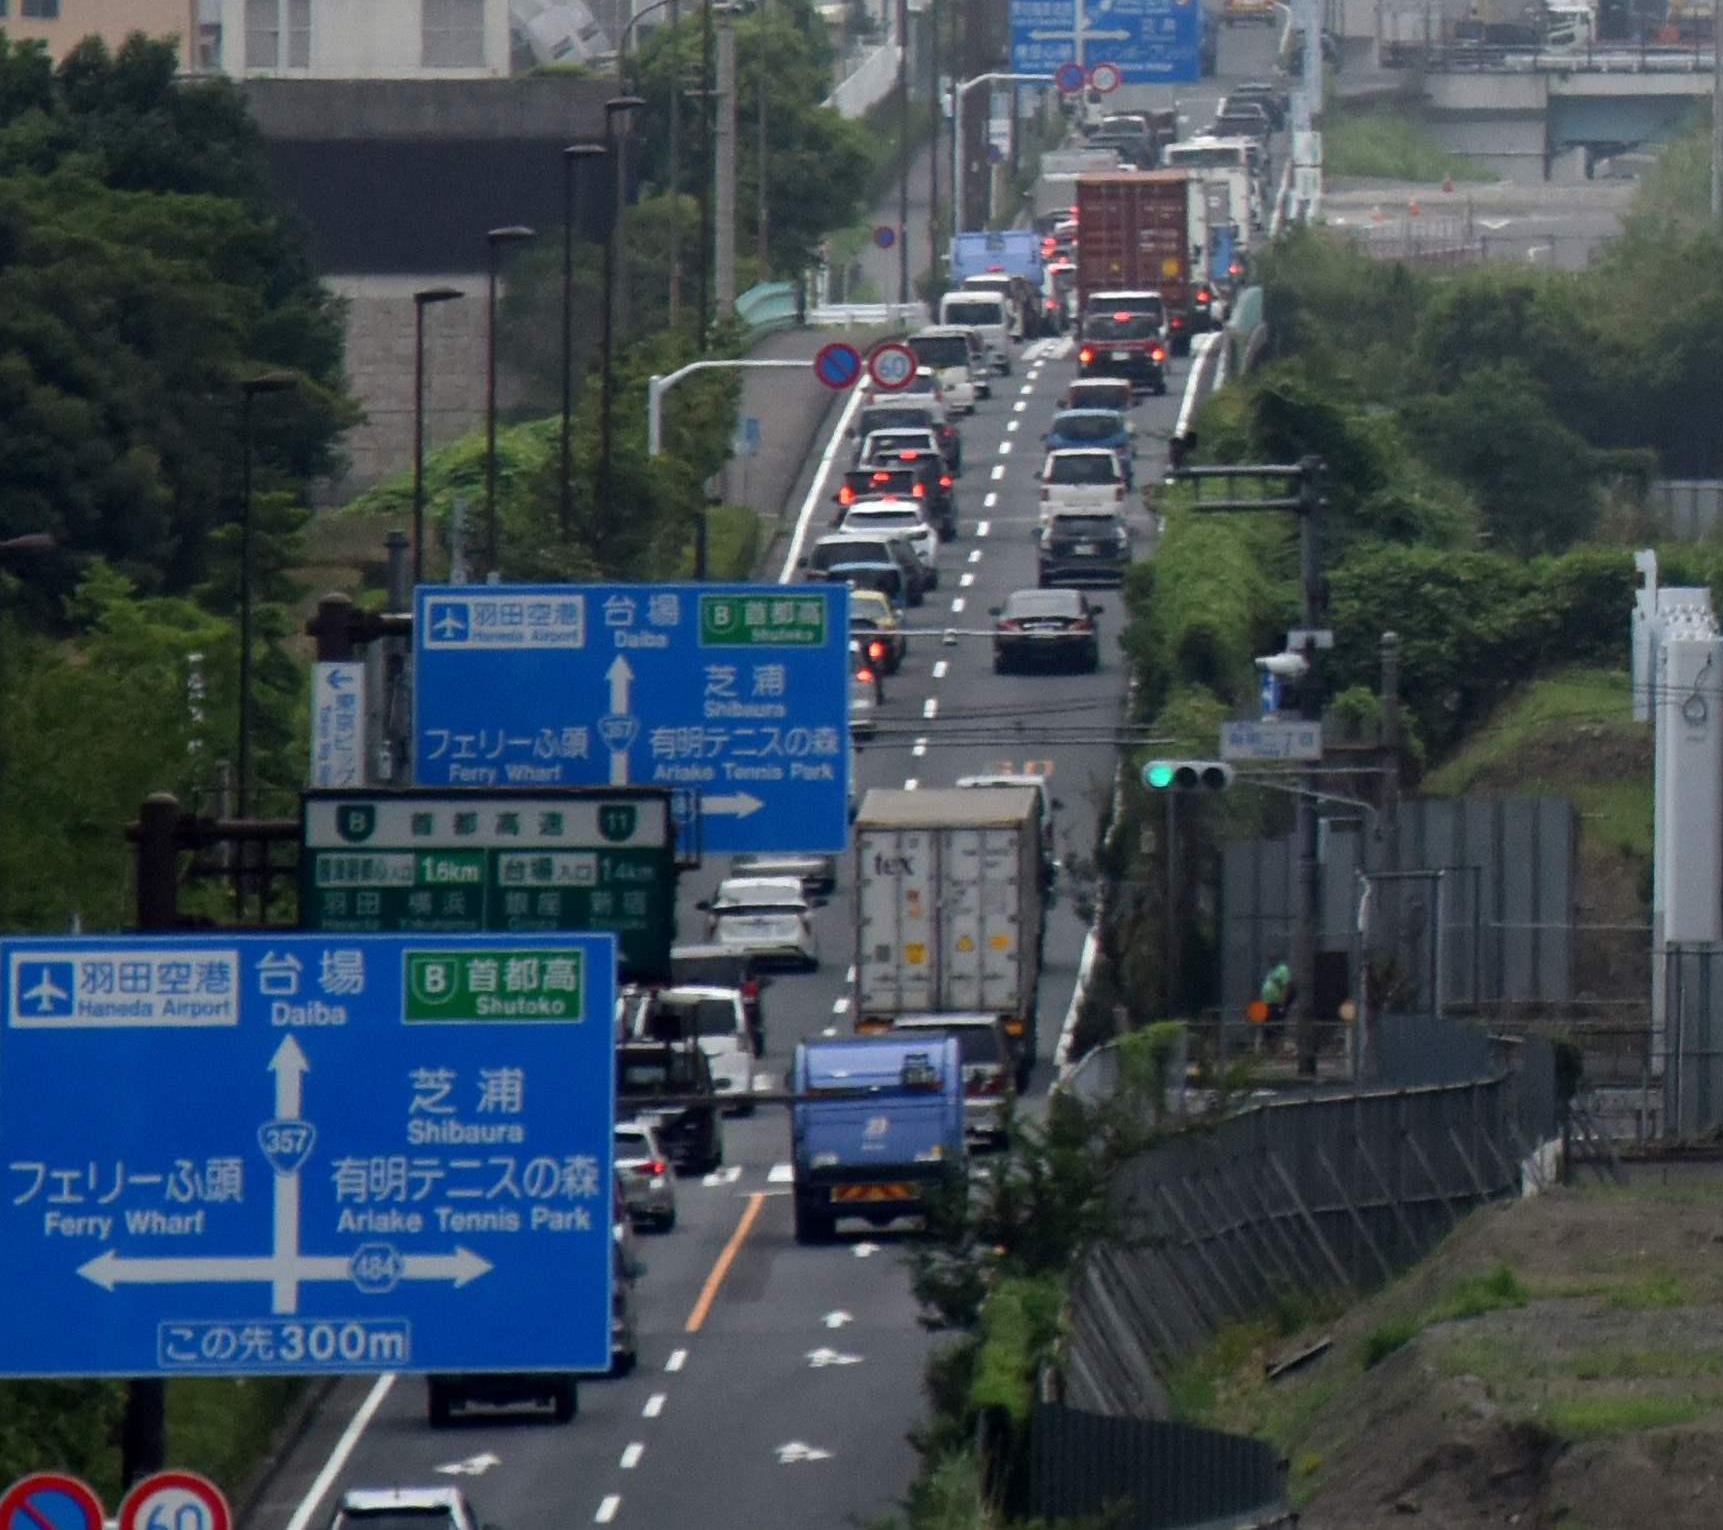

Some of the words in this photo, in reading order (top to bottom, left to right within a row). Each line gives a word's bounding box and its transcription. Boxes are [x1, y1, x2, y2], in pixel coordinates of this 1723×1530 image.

[474, 603, 577, 627] 羽田空港
[602, 594, 680, 627] 台場
[714, 605, 729, 625] B
[613, 631, 668, 648] Daiba
[704, 664, 785, 697] 芝浦
[704, 700, 786, 718] Shibaura
[424, 726, 588, 760] フェリーふ頭
[650, 726, 838, 760] 有明テニスの森
[449, 764, 496, 785] Ferry
[505, 764, 562, 782] Wharf
[653, 763, 715, 781] Ariake
[721, 763, 784, 781] Tennis
[790, 763, 834, 780] Park
[349, 814, 367, 832] B
[411, 811, 564, 836] 首都高速
[607, 814, 628, 832] 11
[80, 960, 232, 995] 羽田空港
[255, 949, 365, 995] 台場
[424, 965, 446, 993] B
[466, 958, 577, 993] 首都高
[78, 999, 152, 1018] Haneda
[162, 999, 230, 1019] Airport
[271, 1002, 347, 1026] Daiba
[475, 996, 566, 1015] Shutoko
[408, 1067, 525, 1114] 芝浦
[265, 1129, 307, 1155] 357
[407, 1119, 525, 1145] Shibaura
[10, 1157, 243, 1206] フェリーふ頭
[331, 1155, 599, 1204] 有明テニスの森
[44, 1210, 113, 1240] Ferry
[125, 1210, 205, 1235] Wharf
[337, 1209, 423, 1233] Ariake
[434, 1208, 520, 1232] Tennis
[531, 1208, 592, 1231] Park
[353, 1255, 400, 1281] 484
[165, 1324, 403, 1361] この先300m
[147, 1503, 208, 1530] 60
